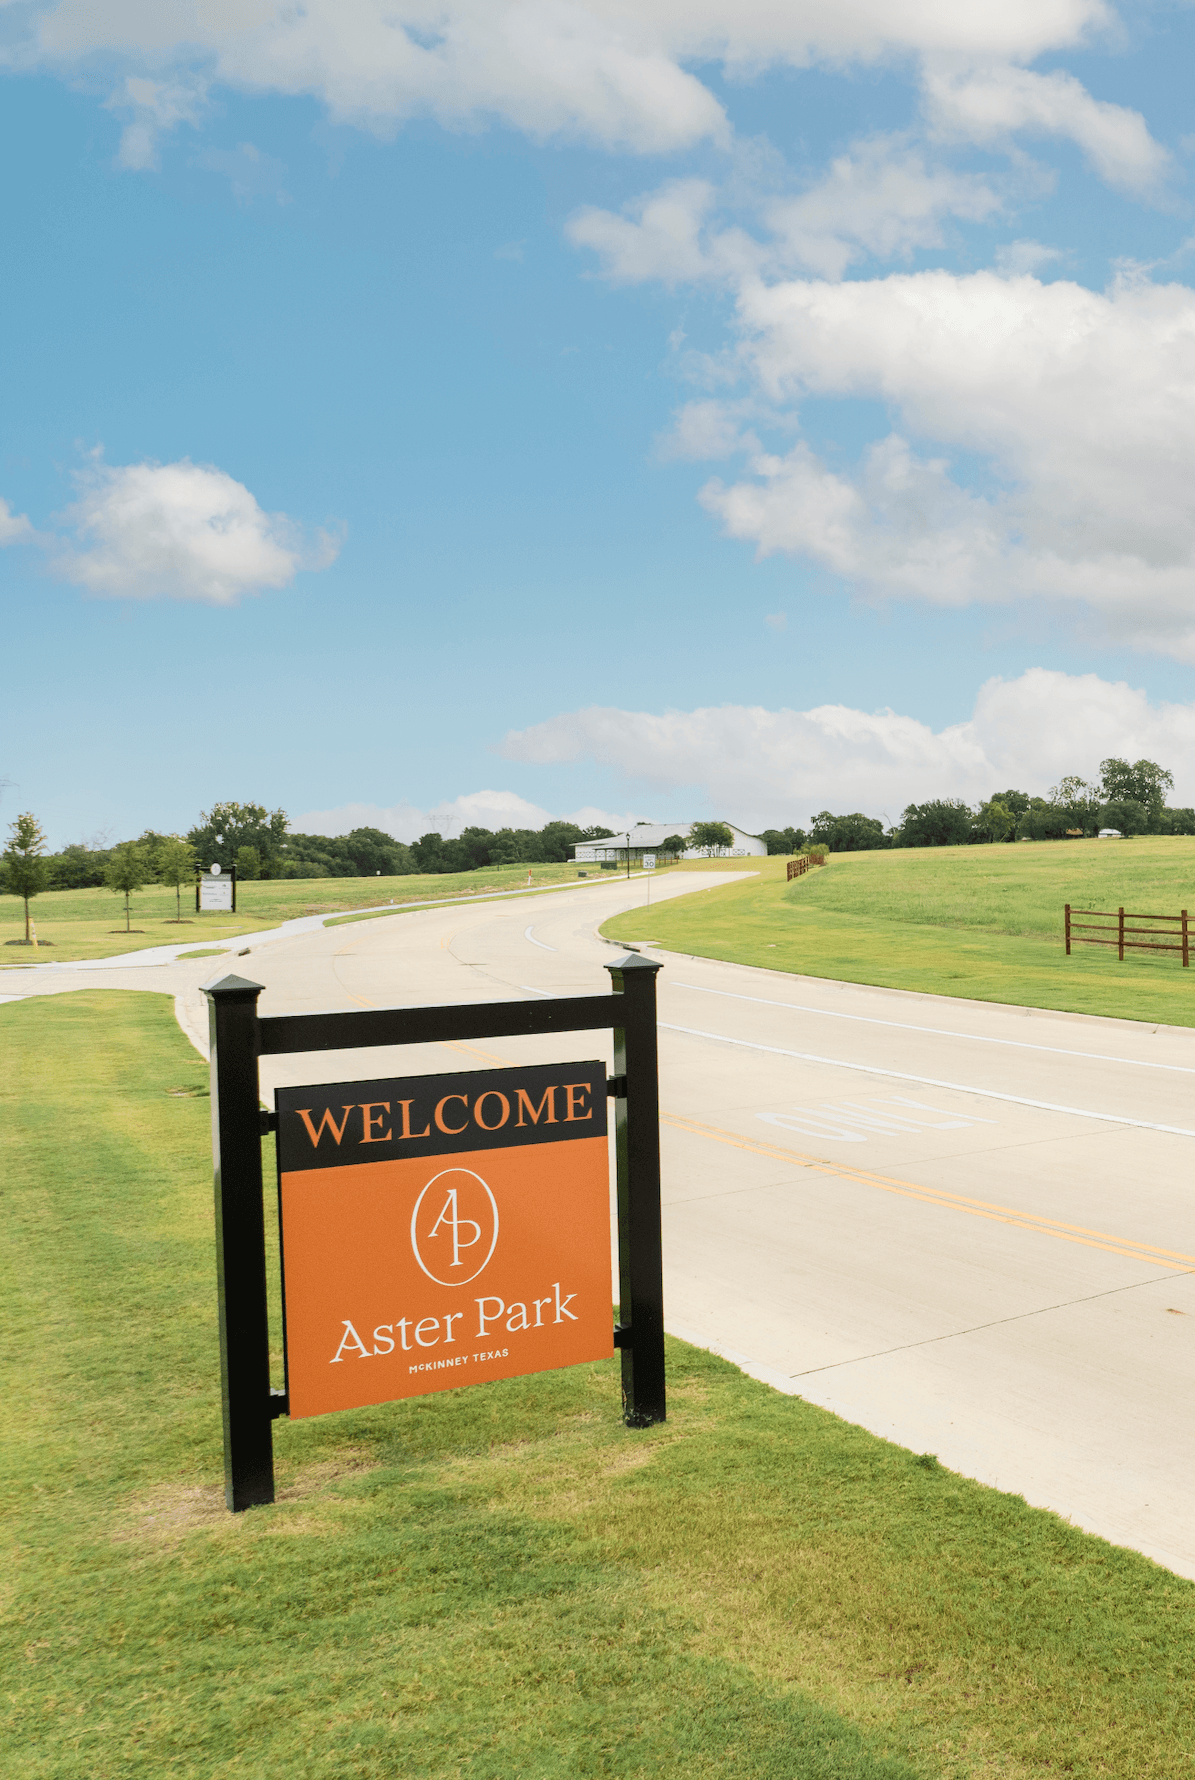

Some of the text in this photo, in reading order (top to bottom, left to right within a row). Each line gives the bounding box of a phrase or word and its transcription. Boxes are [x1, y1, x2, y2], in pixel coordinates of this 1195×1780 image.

[295, 1082, 593, 1149] WELCOME
[754, 1095, 1000, 1142] ONLY
[427, 1188, 482, 1266] AP
[329, 1282, 579, 1364] Aster Park
[473, 1348, 509, 1362] TEXAS
